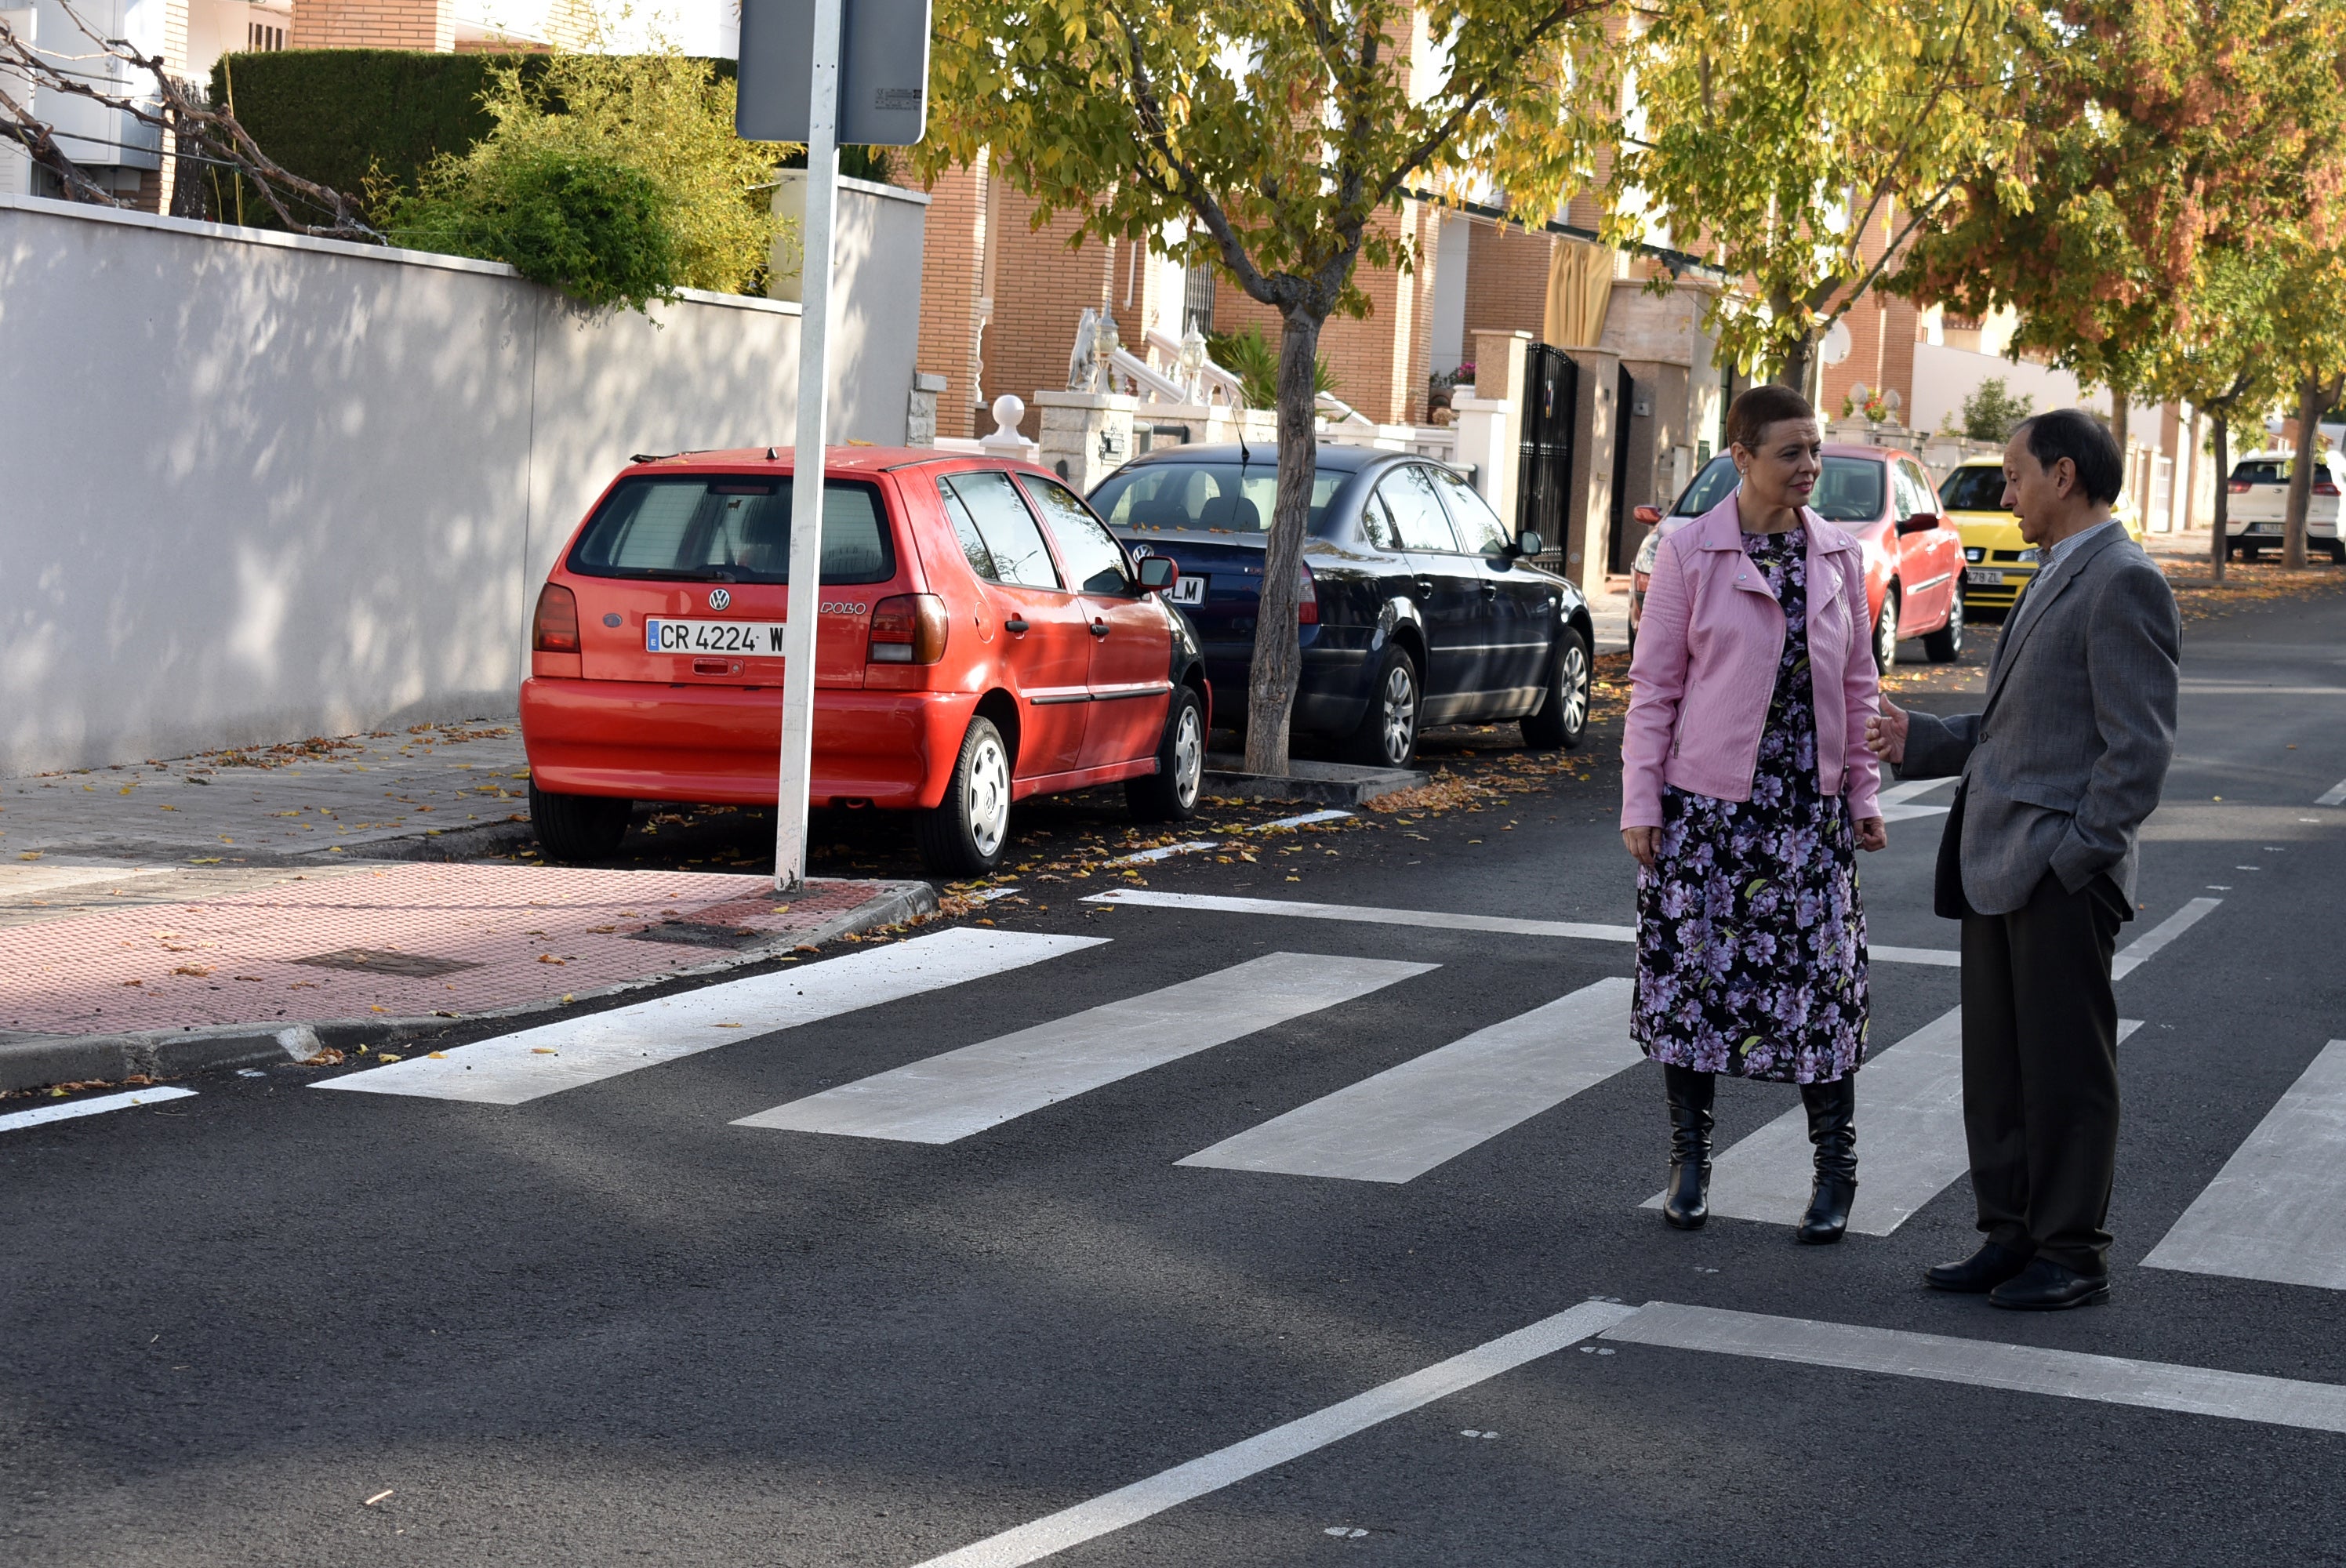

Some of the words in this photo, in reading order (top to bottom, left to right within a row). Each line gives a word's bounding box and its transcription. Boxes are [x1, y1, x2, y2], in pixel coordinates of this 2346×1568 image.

[1165, 581, 1198, 601] LM
[820, 602, 866, 615] POLO
[661, 625, 689, 649] CR
[695, 626, 755, 652] 4224
[769, 627, 783, 652] W
